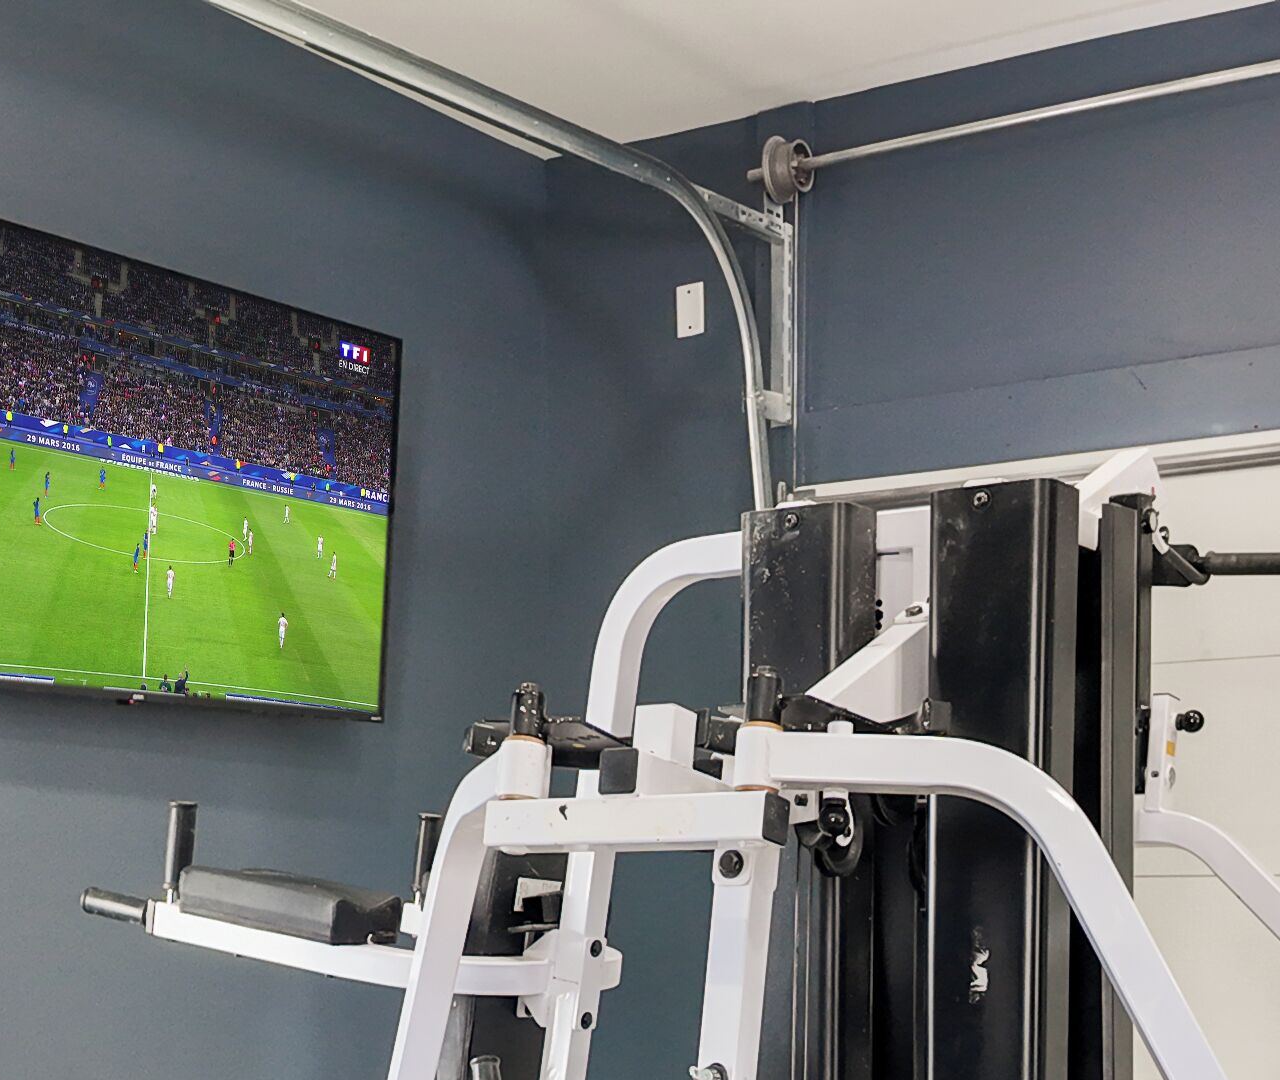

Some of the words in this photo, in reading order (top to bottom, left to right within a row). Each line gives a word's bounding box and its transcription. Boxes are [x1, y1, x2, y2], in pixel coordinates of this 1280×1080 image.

[338, 359, 348, 369] EN
[348, 362, 370, 375] DIRECT
[26, 434, 37, 443] 29
[38, 437, 61, 449] MARS
[62, 442, 81, 452] 2016
[121, 453, 147, 465] ÉQUIPE
[155, 460, 182, 472] FRANCE
[242, 478, 267, 490] FRANCE
[272, 484, 294, 495] RUSSIE
[329, 496, 337, 504] 29
[338, 498, 355, 508] MARS
[356, 501, 372, 511] 2016
[361, 488, 390, 503] RANC
